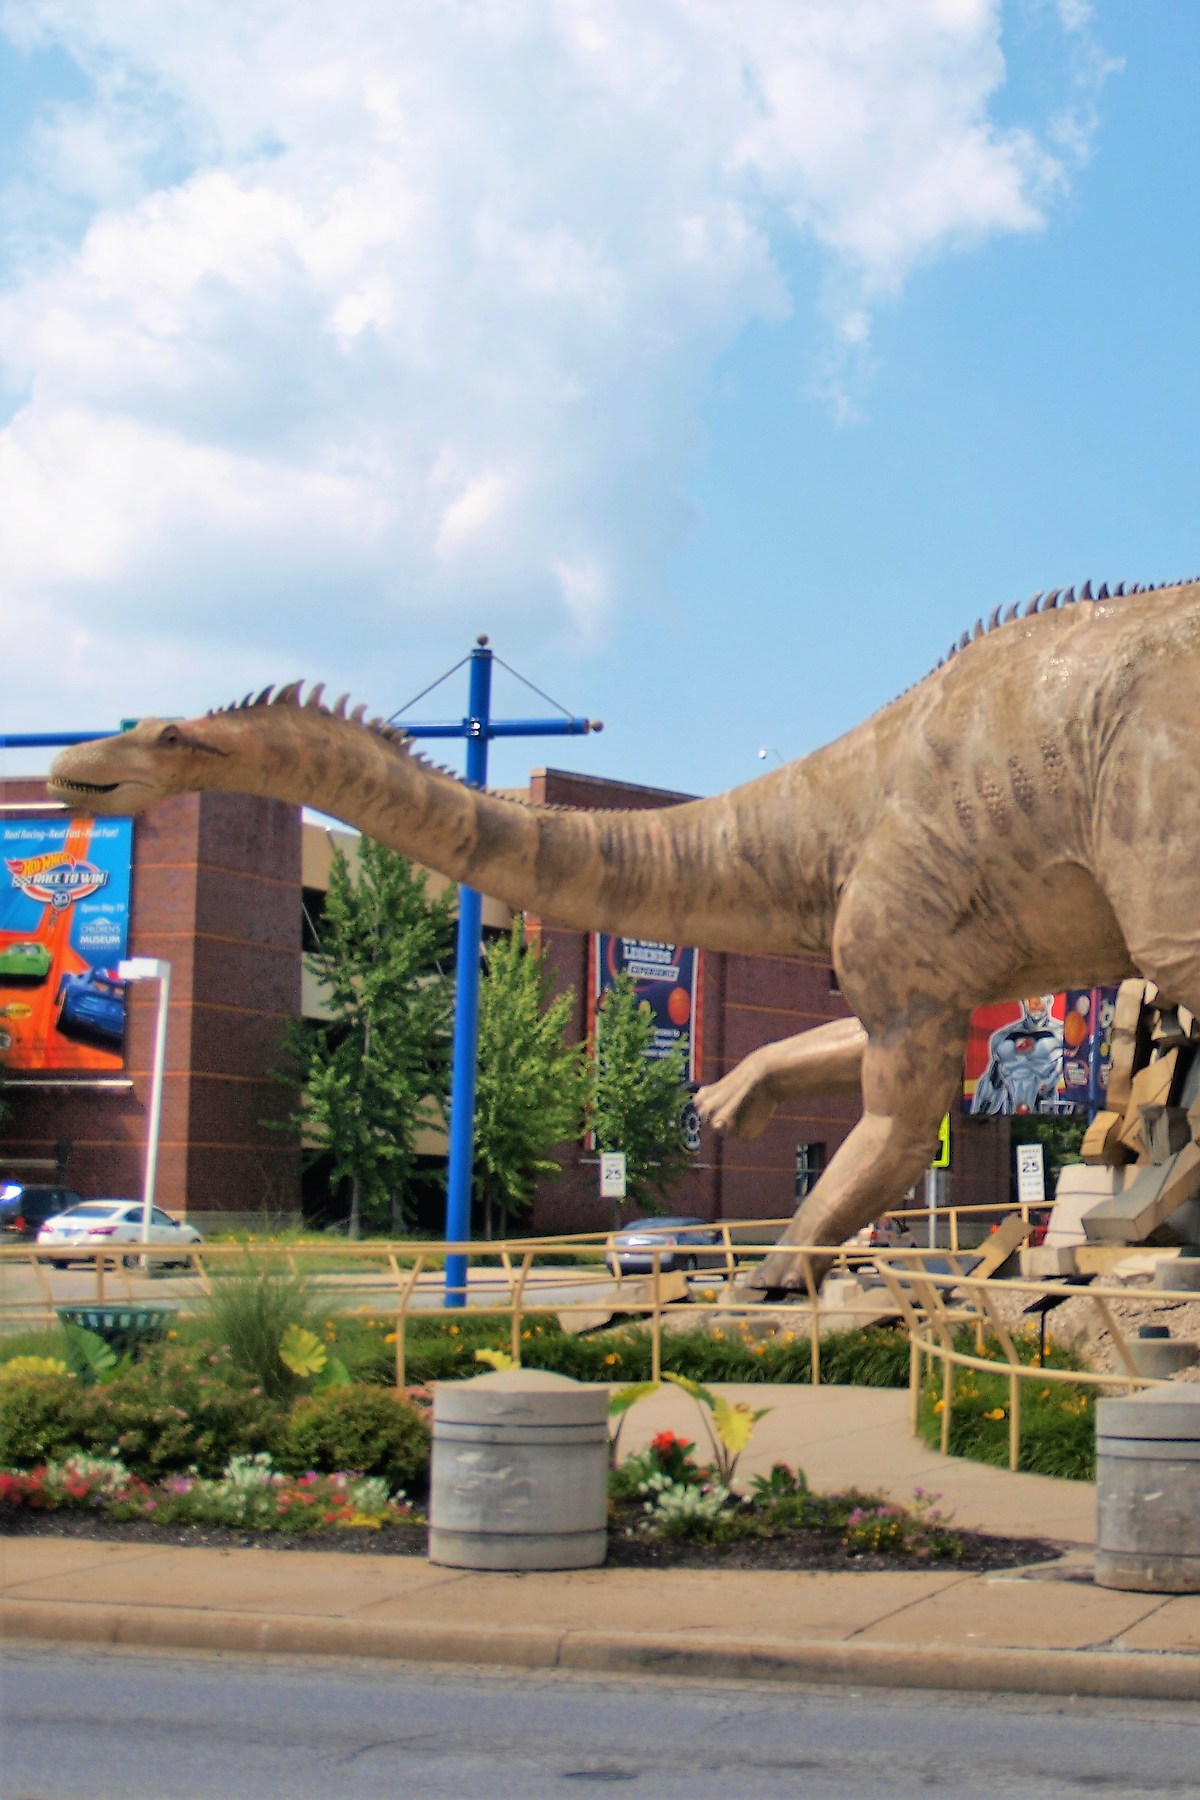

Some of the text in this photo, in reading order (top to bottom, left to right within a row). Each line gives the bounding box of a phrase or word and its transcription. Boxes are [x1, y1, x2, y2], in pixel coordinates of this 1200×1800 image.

[64, 873, 79, 884] TO
[81, 872, 104, 885] WIN
[80, 935, 120, 944] MUSEUM
[1022, 1161, 1040, 1173] 25
[605, 1168, 622, 1180] 25
